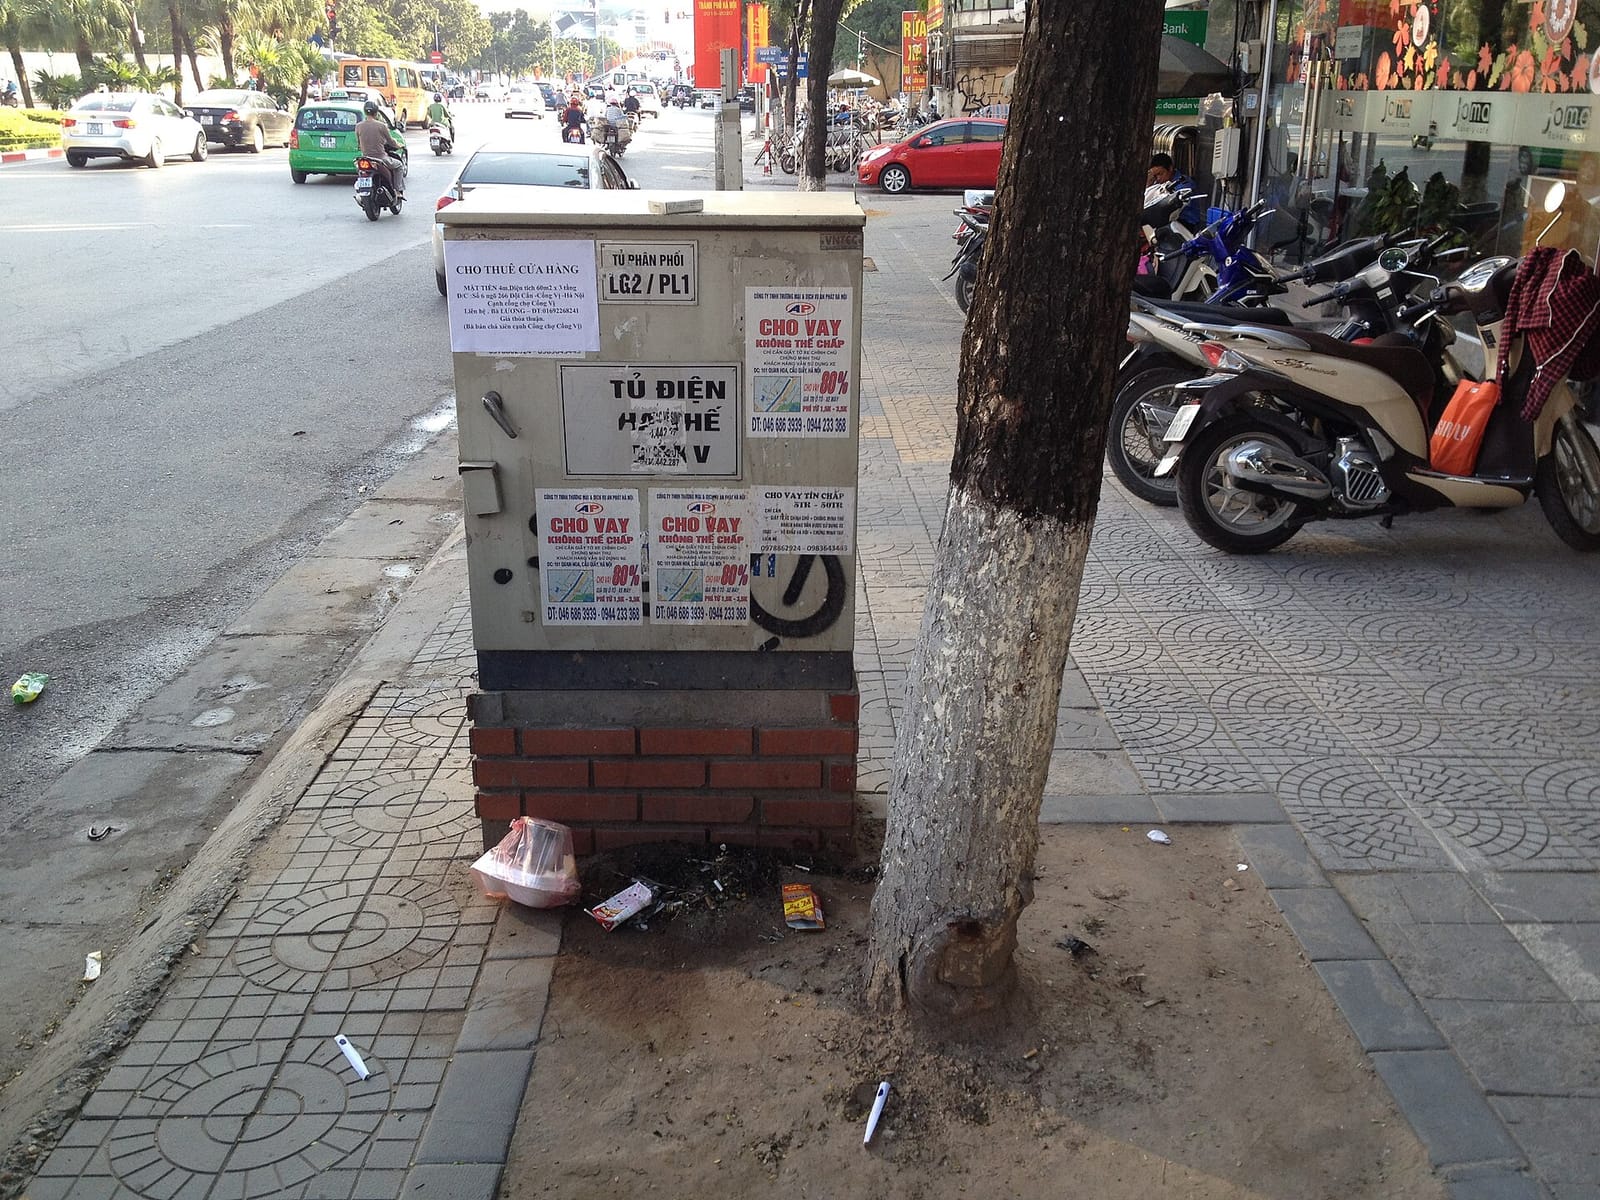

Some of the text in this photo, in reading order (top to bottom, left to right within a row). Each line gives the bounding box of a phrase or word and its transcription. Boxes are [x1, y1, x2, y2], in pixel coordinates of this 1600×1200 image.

[903, 14, 927, 37] RỬA
[612, 249, 684, 266] TỦ PHÂN PHỐI
[456, 262, 579, 275] CHO THUÊ CỬA HÀNG
[609, 273, 689, 294] LG2 / PL1
[787, 305, 812, 313] AP
[759, 319, 842, 336] CHO VAY
[755, 336, 845, 348] KHÔNG THẾ CHẤP
[610, 372, 726, 404] TỦ ĐIỆN
[820, 371, 849, 395] 80%
[752, 418, 846, 432] ĐT: 046 686 3939 0944 233 368
[765, 489, 845, 500] CHO VAY TÍN CHẤP
[689, 504, 712, 512] AP
[551, 518, 630, 533] CHO VAY
[662, 517, 741, 532] CHO VAY
[548, 534, 634, 544] KHÔNG THẾ CHẤP
[659, 533, 744, 544] KHÔNG THẾ CHẤP
[612, 564, 640, 586] 80%
[721, 564, 749, 586] 80%
[548, 607, 640, 620] ĐT: 046 686 3939 0944 233 368
[656, 606, 747, 620] ĐT: 046 686 3939 0944 233 368
